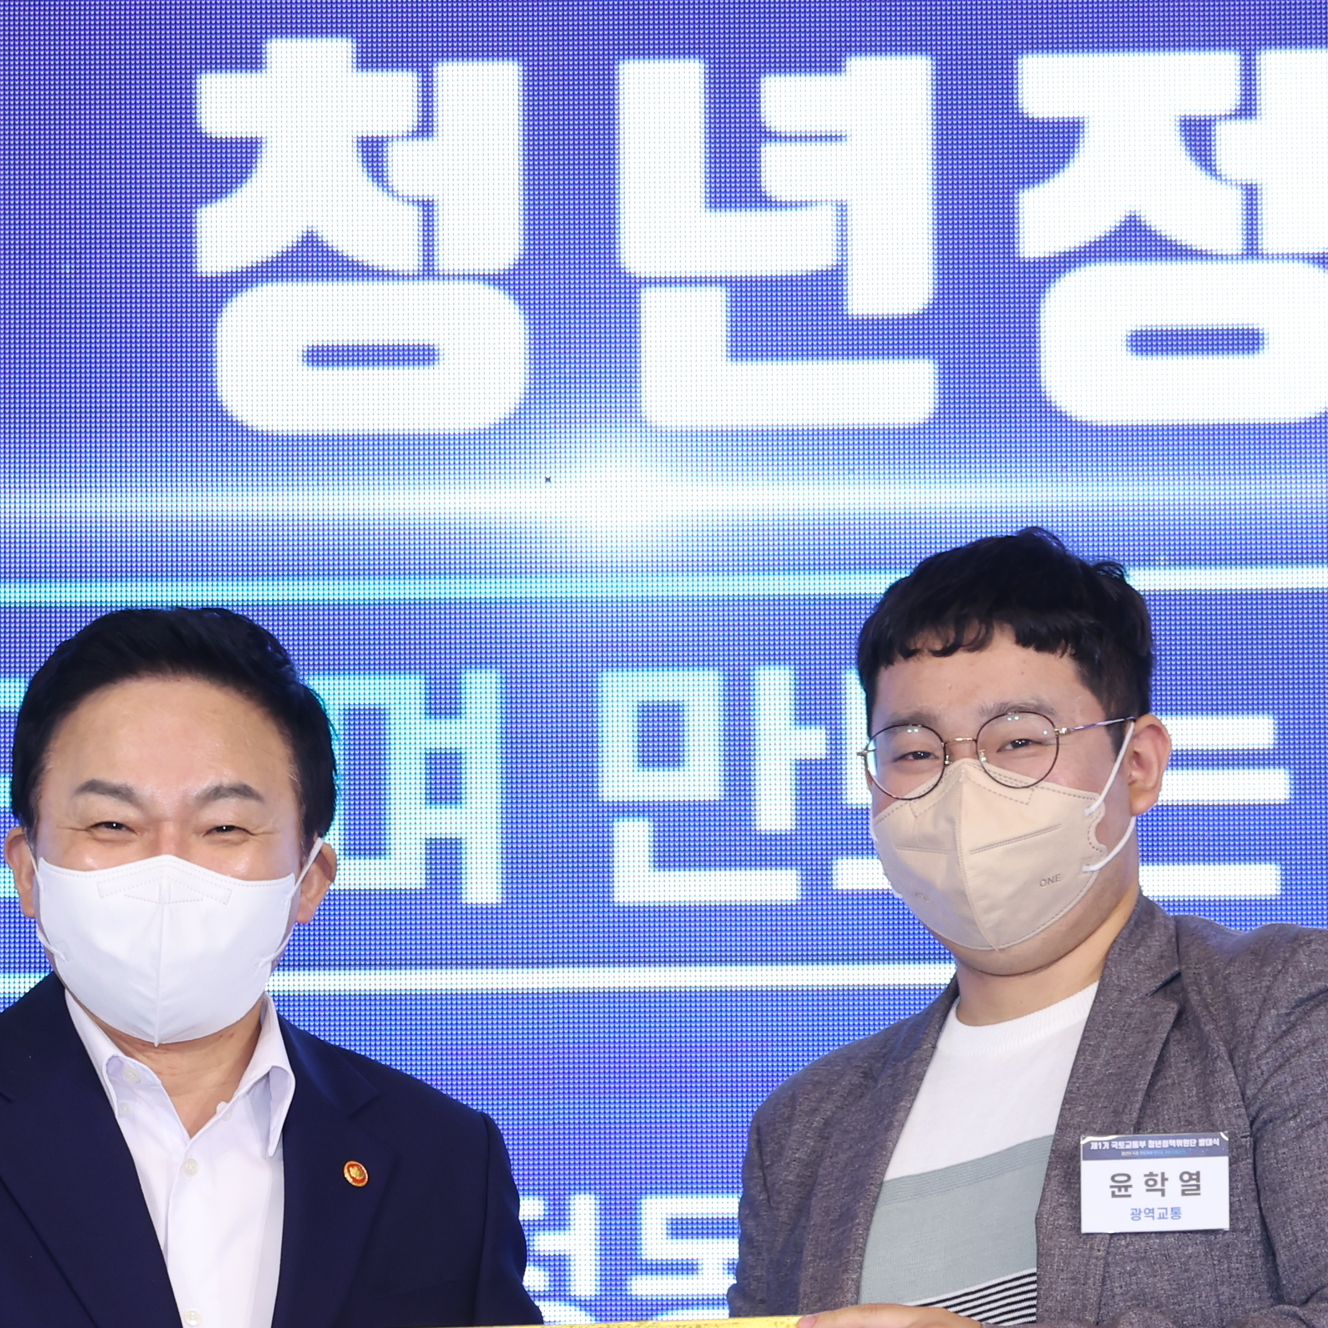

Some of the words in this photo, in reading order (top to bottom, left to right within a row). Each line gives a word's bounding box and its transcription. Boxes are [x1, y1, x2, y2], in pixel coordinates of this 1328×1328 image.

[1039, 873, 1062, 888] ONE
[1090, 1141, 1110, 1150] 제1기
[1110, 1140, 1147, 1149] 국토교통부
[1130, 1207, 1182, 1222] 광역교통
